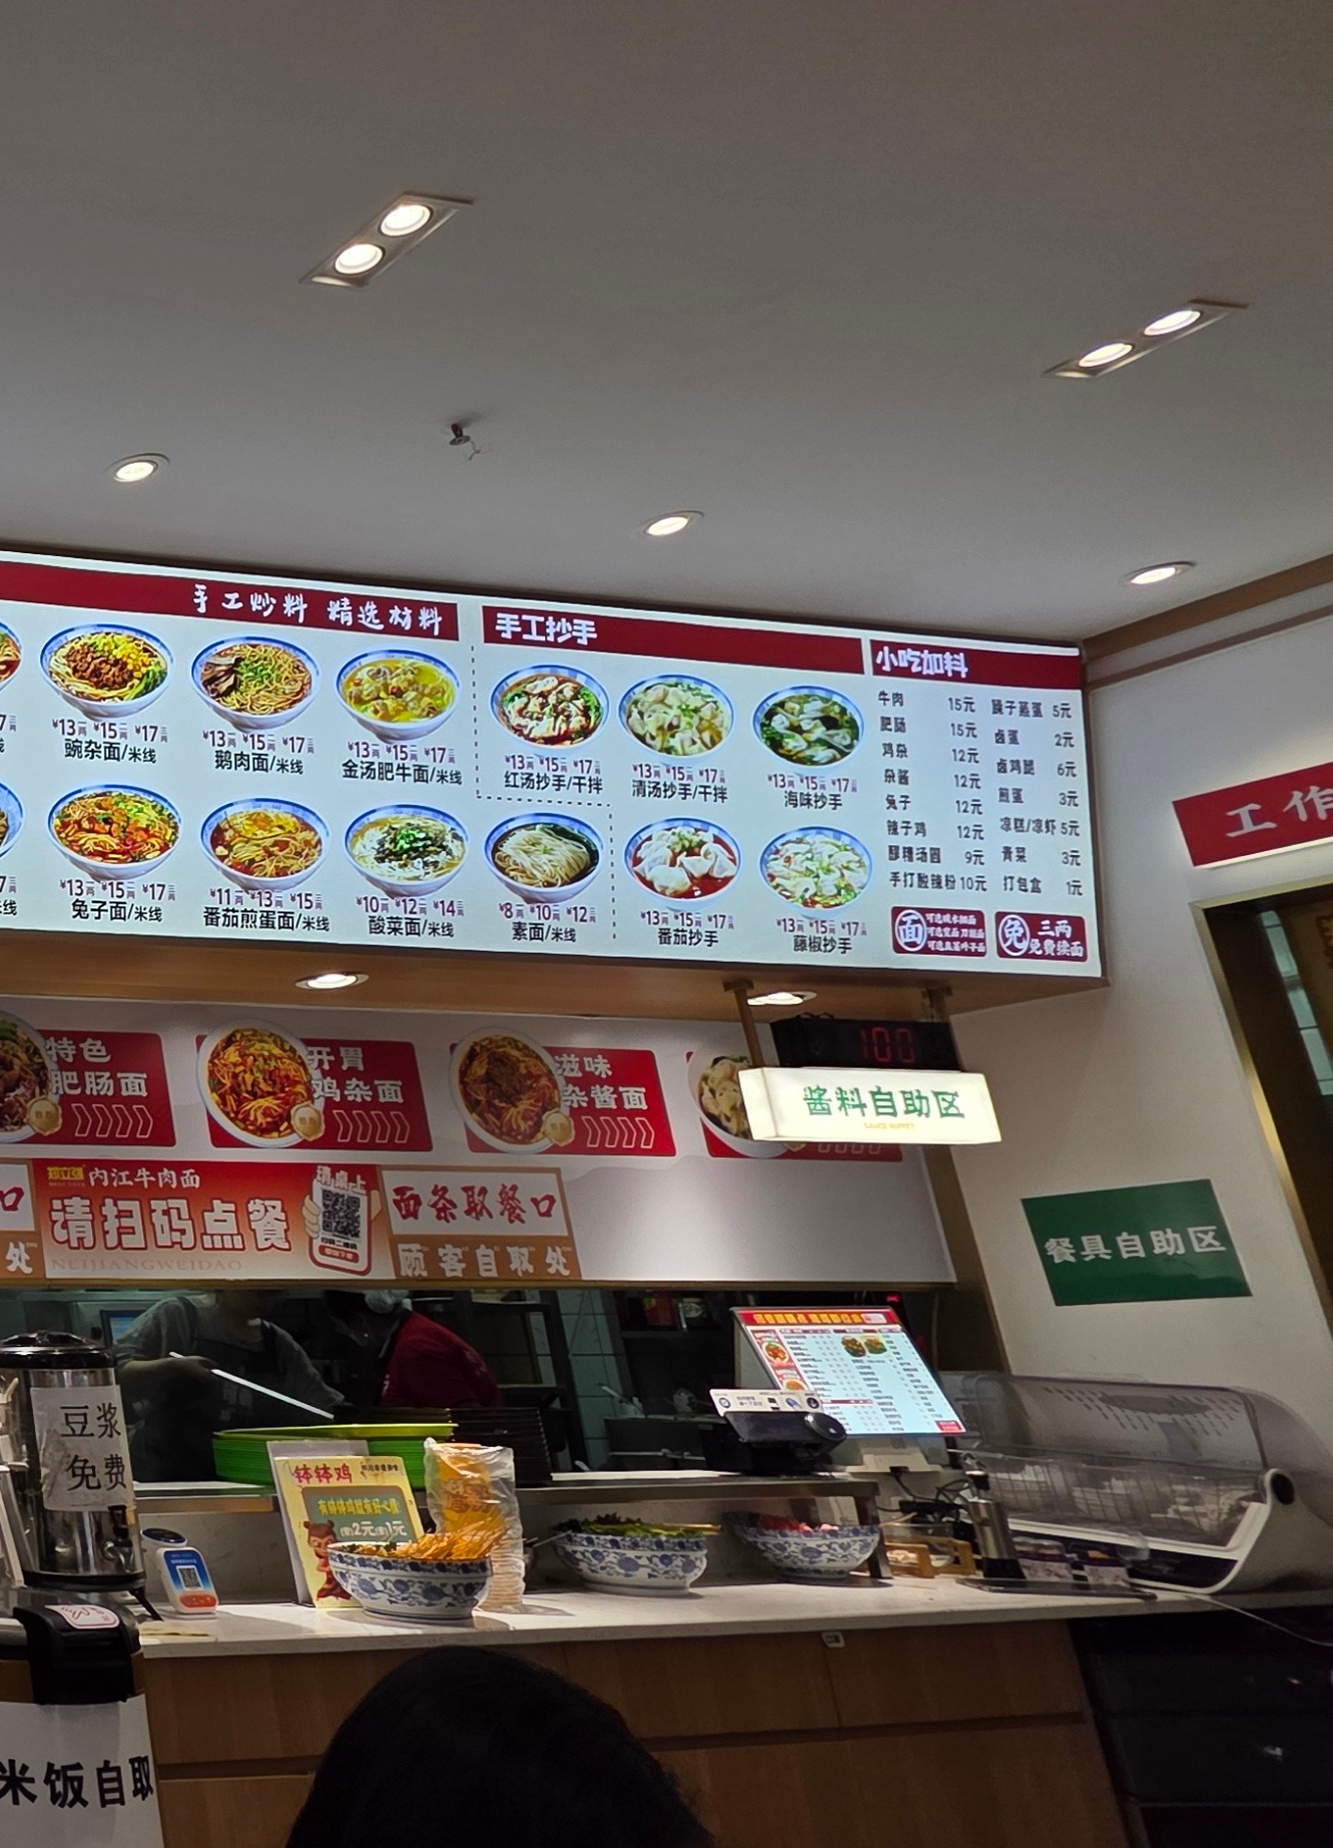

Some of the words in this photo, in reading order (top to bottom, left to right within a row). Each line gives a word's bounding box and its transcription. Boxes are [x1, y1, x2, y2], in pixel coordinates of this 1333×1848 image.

[193, 584, 308, 623] 手工炒料
[327, 597, 443, 636] 精选材料
[495, 613, 598, 645] 手工抄手
[876, 646, 968, 678] 小吃加料
[878, 690, 904, 707] 牛肉
[948, 697, 976, 713] 15元
[1052, 703, 1072, 719] 5元
[880, 716, 906, 733] 肥肠
[950, 722, 977, 739] 15元
[994, 729, 1020, 745] 卤蛋
[1055, 732, 1074, 748] 2元
[64, 739, 157, 764] 豌杂面/米线
[215, 750, 304, 775] 鹅肉面/米线
[882, 743, 908, 759] 鸡杂
[952, 748, 980, 764] 12元
[342, 759, 462, 785] 金汤肥牛面/米线
[884, 768, 909, 785] 杂酱
[954, 773, 981, 790] 12元
[997, 758, 1035, 775] 卤鸡腿
[1057, 762, 1077, 778] 6元
[504, 772, 603, 793] 红汤抄手/干拌
[632, 780, 728, 803] 清汤抄手/干拌
[784, 790, 843, 810] 海味抄手
[885, 794, 910, 811] 兔子
[956, 799, 983, 815] 12元
[999, 787, 1024, 804] 煎蛋
[1059, 791, 1079, 807] 3元
[1225, 785, 1333, 838] 工作
[957, 824, 984, 840] 12元
[1060, 820, 1080, 837] 5元
[964, 850, 985, 866] 9元
[1002, 846, 1027, 863] 青菜
[1062, 850, 1081, 867] 3元
[960, 875, 987, 892] 10元
[1003, 875, 1042, 894] 打包盒
[1067, 879, 1083, 896] 1元
[72, 898, 163, 922] 兔子面/米线
[203, 907, 330, 932] 番茄煎蛋面/米线
[368, 915, 454, 938] 酸菜面/米线
[512, 922, 576, 943] 素面/米线
[658, 928, 719, 948] 番茄抄手
[898, 919, 924, 947] 面
[1004, 919, 1026, 950] 免
[1038, 919, 1072, 938] 三两
[793, 935, 853, 954] 藤椒抄手
[46, 1037, 110, 1063] 特色
[307, 1047, 365, 1072] 开胃
[553, 1053, 612, 1078] 滋味
[50, 1070, 148, 1098] 肥肠面
[311, 1078, 403, 1104] 鸡杂面
[560, 1084, 647, 1111] 杂酱面
[803, 1085, 965, 1119] 酱料自助区
[88, 1167, 201, 1189] 内江牛肉面
[392, 1183, 557, 1224] 面条取餐口
[50, 1196, 292, 1252] 请扫码点餐
[1044, 1226, 1226, 1265] 餐具自助区
[51, 1258, 242, 1271] NEIJIANGWEIDAO
[398, 1243, 571, 1278] 顾客自取处
[59, 1403, 121, 1440] 豆浆
[65, 1454, 128, 1492] 免费
[294, 1463, 352, 1484] 钵钵鸡
